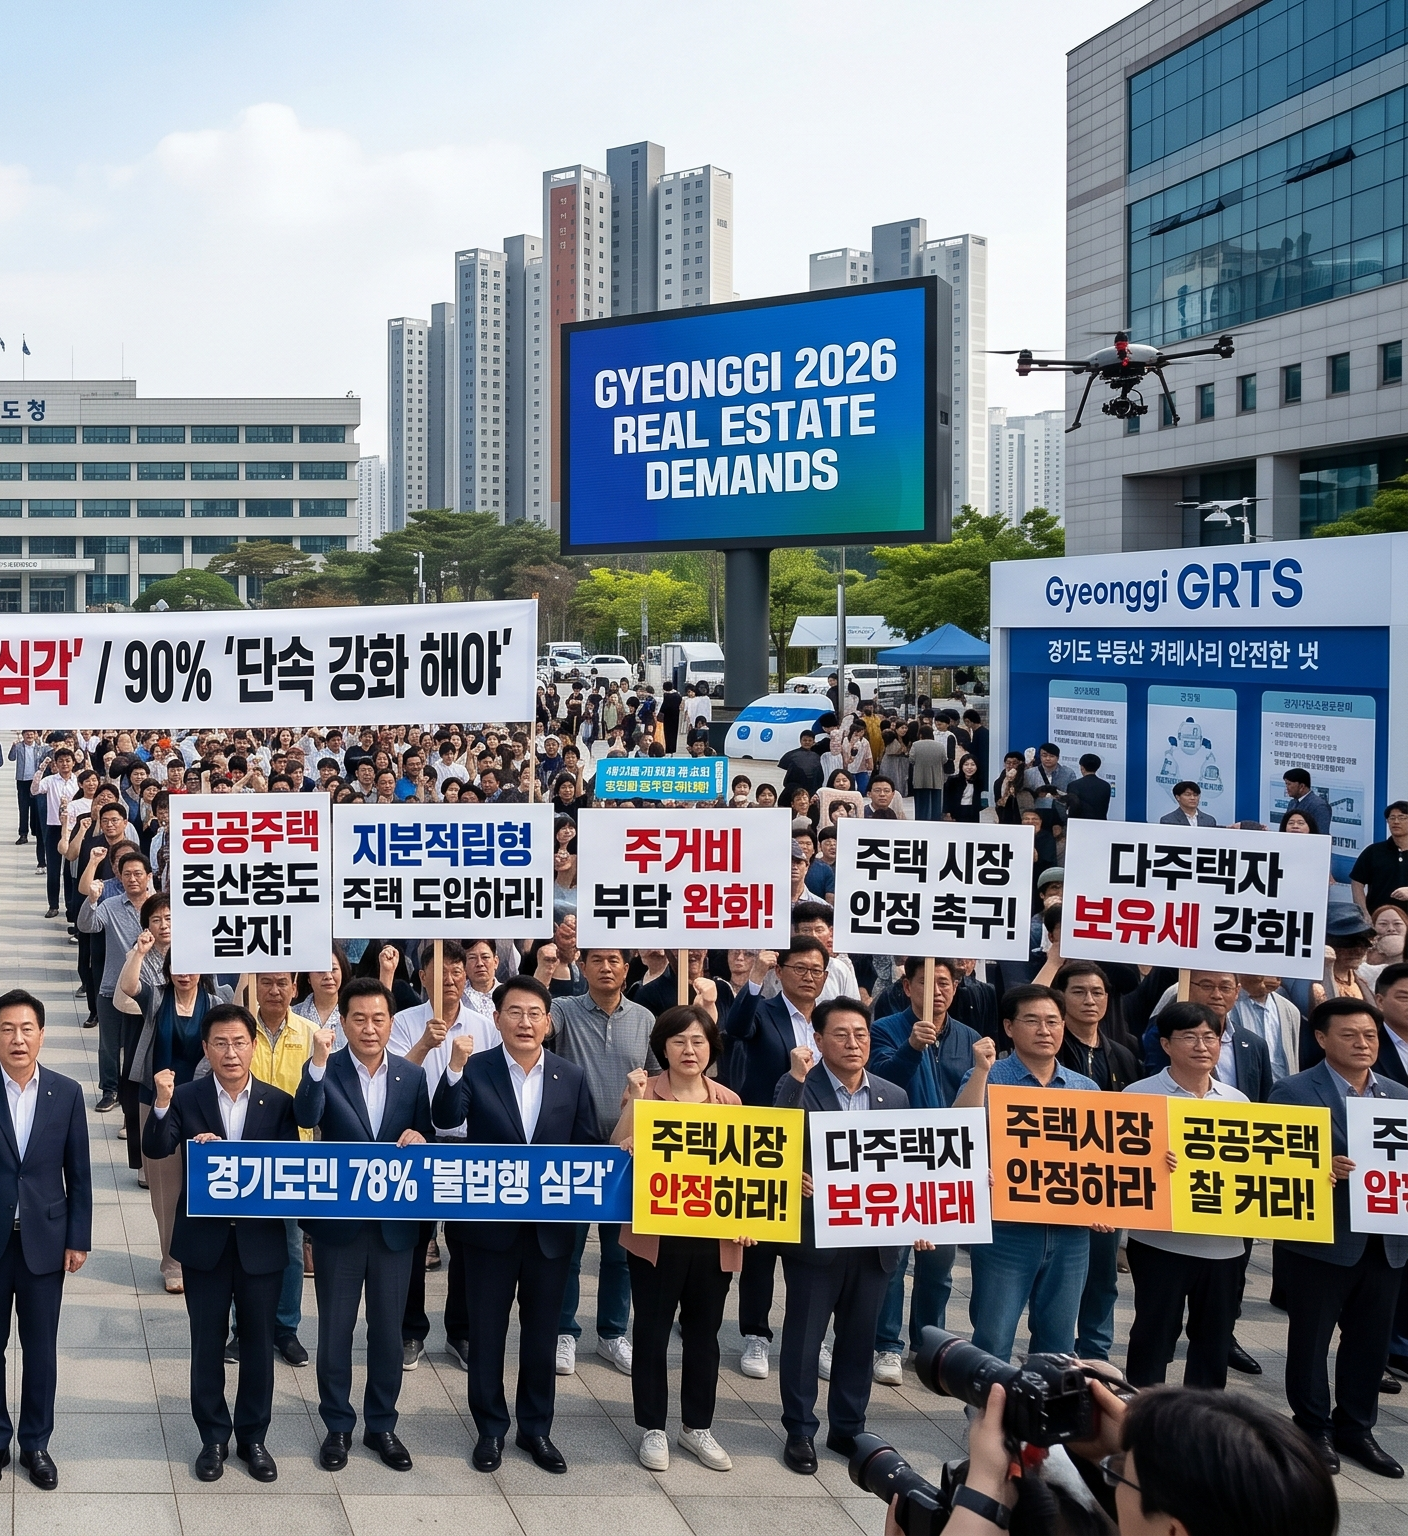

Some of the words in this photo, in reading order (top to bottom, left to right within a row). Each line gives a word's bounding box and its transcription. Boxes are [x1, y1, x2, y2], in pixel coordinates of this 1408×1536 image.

[594, 350, 782, 409] GYEONGGI
[794, 338, 897, 389] 2026
[613, 410, 709, 455] REAL
[721, 393, 877, 447] ESTATE
[646, 448, 839, 500] DEMANDS
[1045, 569, 1169, 613] Gyeonggi
[1177, 557, 1304, 610] GRTS
[93, 640, 112, 704] /
[123, 639, 213, 704] 90%
[224, 634, 315, 703] '단속
[328, 632, 409, 701] 강화
[420, 626, 512, 697] 해야'
[1048, 640, 1092, 664] 경기도
[1228, 640, 1291, 670] 안전한
[181, 811, 320, 855] 공공주택
[353, 822, 532, 867] 지분적립형
[624, 828, 741, 874] 주거비
[182, 862, 320, 907] 중산충도
[854, 838, 928, 882] 주택
[938, 841, 1013, 887] 시장
[1108, 842, 1284, 898] 다주택자
[343, 877, 402, 920] 주택
[412, 877, 543, 920] 도입하라!
[593, 884, 670, 929] 부담
[683, 883, 774, 930] 완화!
[849, 891, 921, 935] 안정
[930, 895, 1016, 940] 촉구!
[211, 914, 292, 957] 살자!
[1073, 894, 1198, 950] 보유세
[1213, 905, 1313, 958] 강화!
[651, 1119, 787, 1169] 주택시장
[826, 1126, 974, 1173] 다주택자
[1006, 1104, 1153, 1156] 주택시장
[1183, 1116, 1320, 1169] 공공주택
[206, 1155, 338, 1200] 경기도민
[348, 1159, 418, 1203] 78%
[424, 1158, 530, 1205] '불법행
[540, 1159, 614, 1206] 심각'
[649, 1172, 787, 1222] 안정하라!
[828, 1180, 975, 1227] 보유세래
[1006, 1158, 1156, 1210] 안정하라
[1189, 1169, 1224, 1214] 찰
[1235, 1174, 1315, 1221] 커라!
